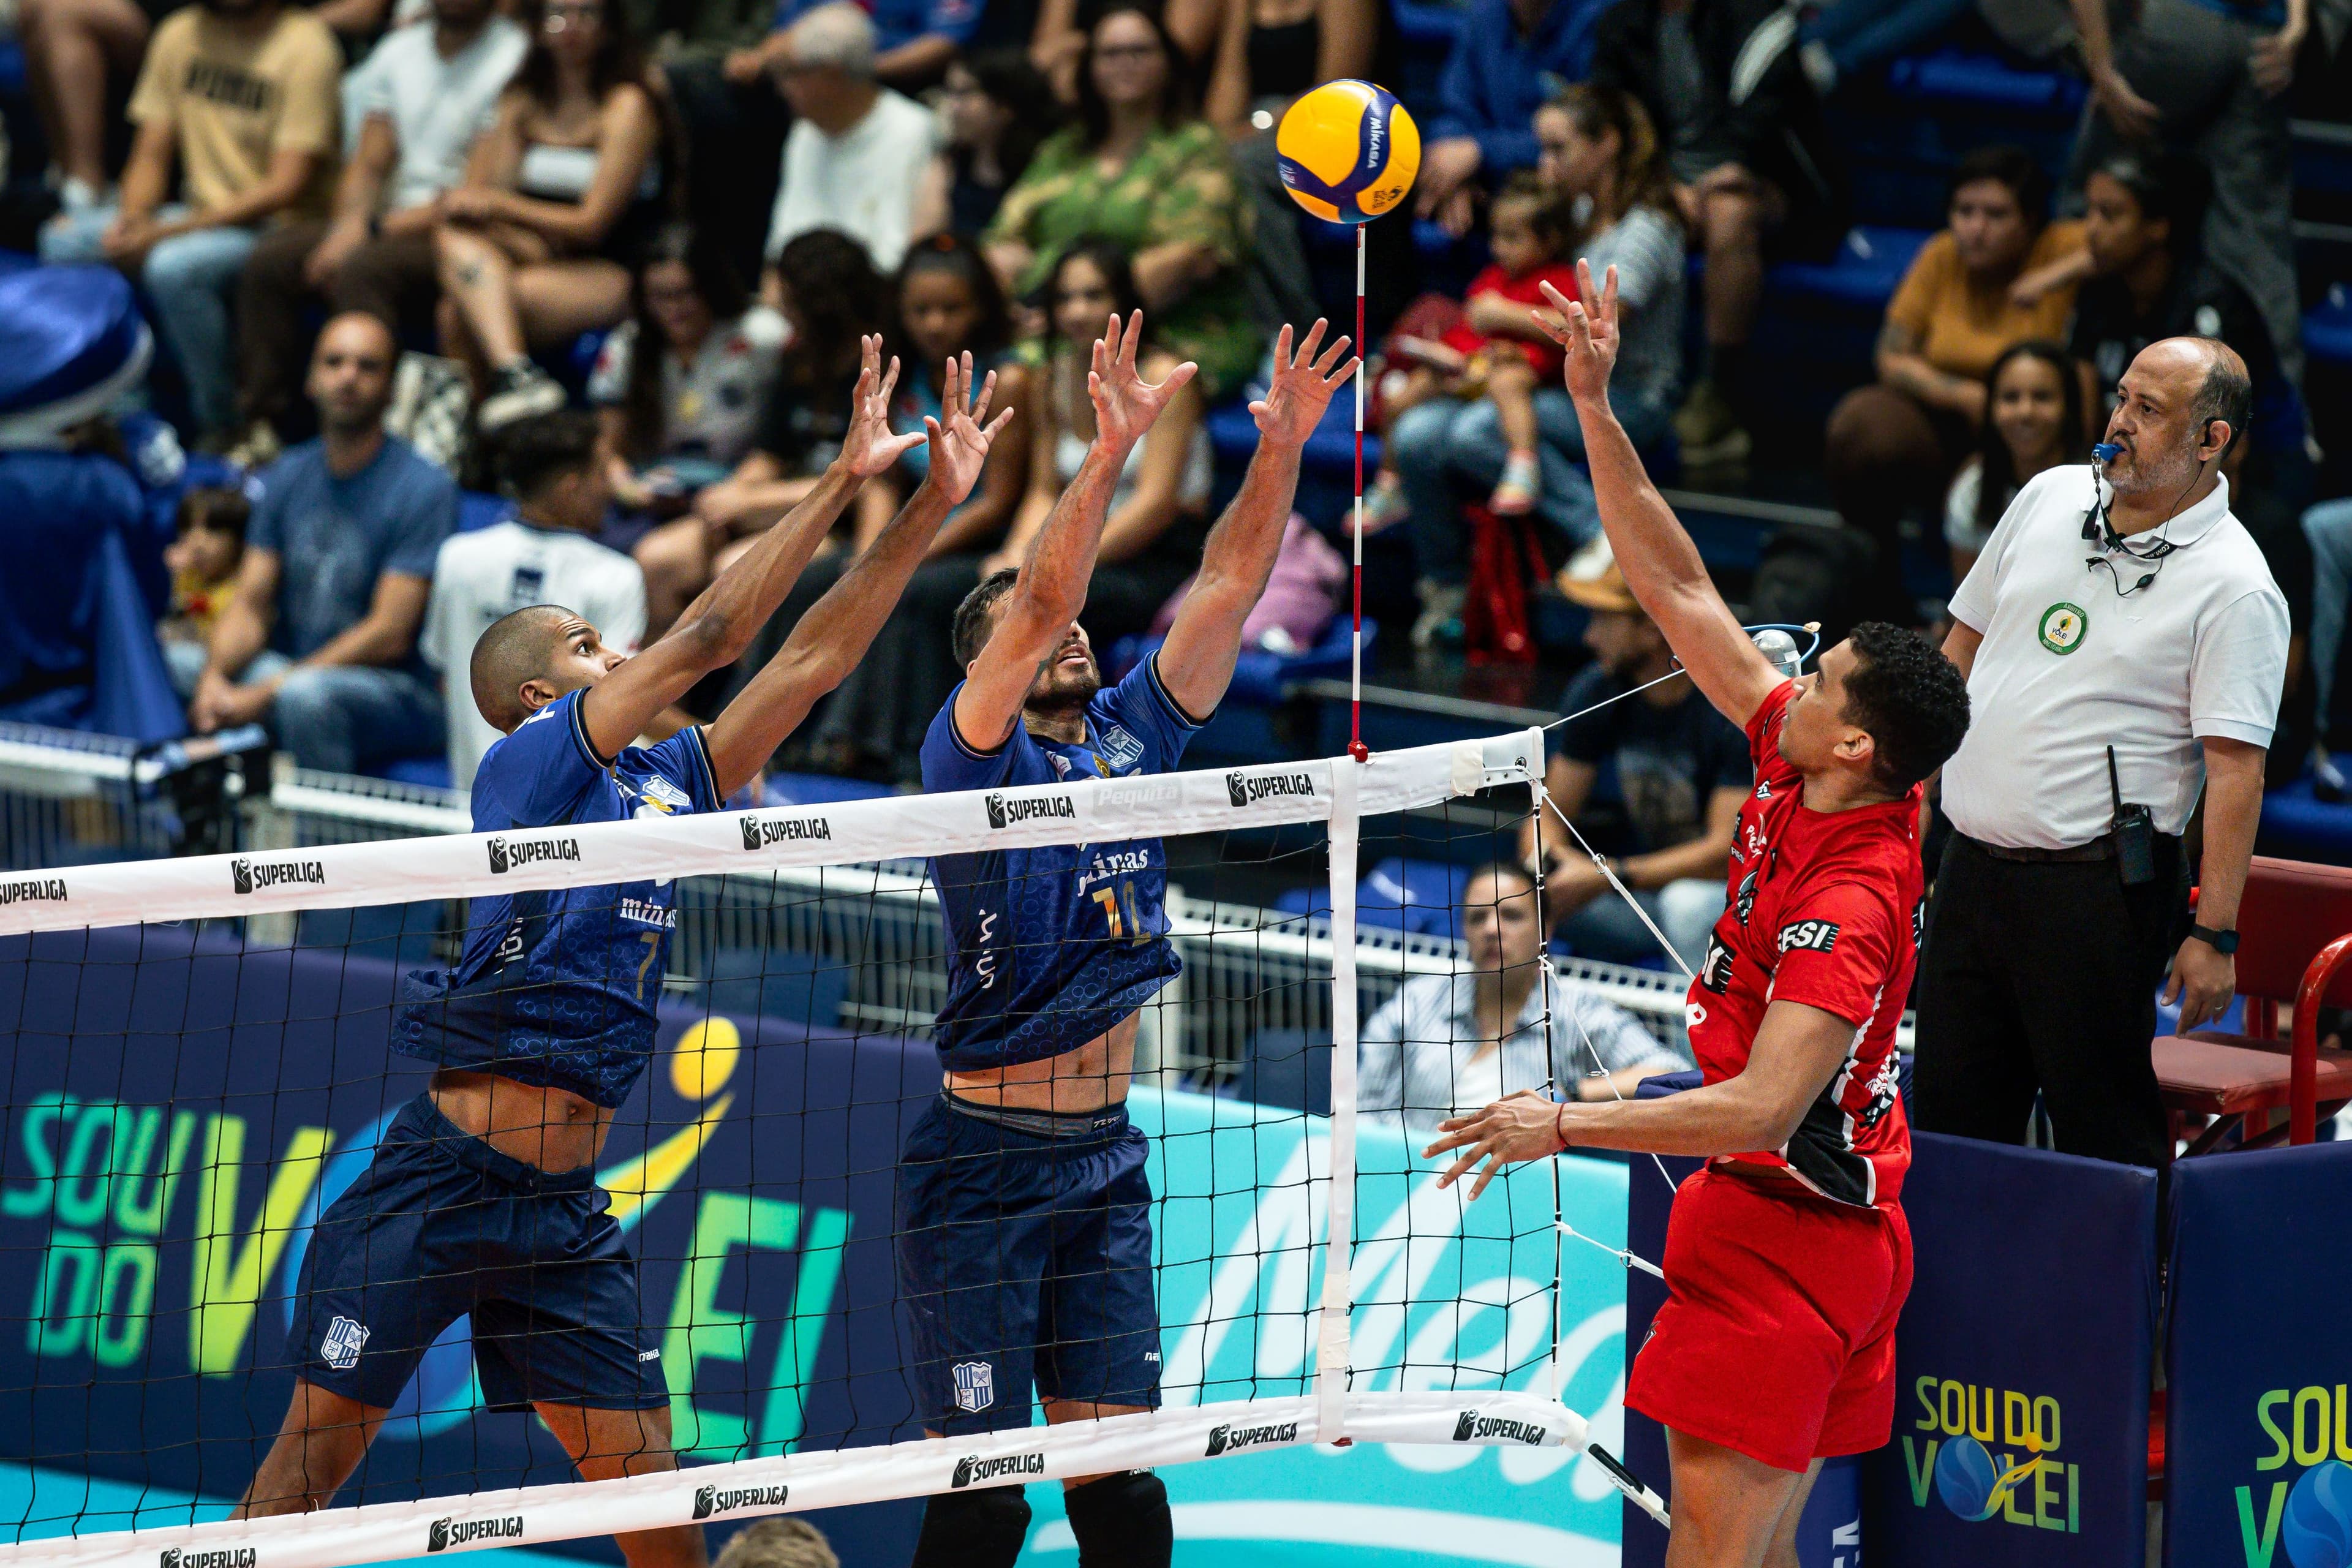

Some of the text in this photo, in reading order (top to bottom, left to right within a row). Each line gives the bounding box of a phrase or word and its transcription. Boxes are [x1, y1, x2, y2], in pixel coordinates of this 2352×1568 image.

[1367, 117, 1384, 168] MIKASA
[1247, 774, 1315, 802] SUPERLIGA
[1007, 796, 1076, 823] SUPERLIGA
[763, 818, 831, 845] SUPERLIGA
[510, 839, 581, 867] SUPERLIGA
[254, 861, 325, 889] SUPERLIGA
[1, 1091, 198, 1235] SOU
[26, 1229, 161, 1367] DO
[1916, 1375, 2061, 1452] SOU DO
[1226, 1422, 1298, 1451] SUPERLIGA
[1474, 1417, 1546, 1446] SUPERLIGA
[973, 1453, 1044, 1482] SUPERLIGA
[714, 1485, 788, 1515] SUPERLIGA
[450, 1516, 523, 1545] SUPERLIGA
[183, 1548, 256, 1568] SUPERLIGA
